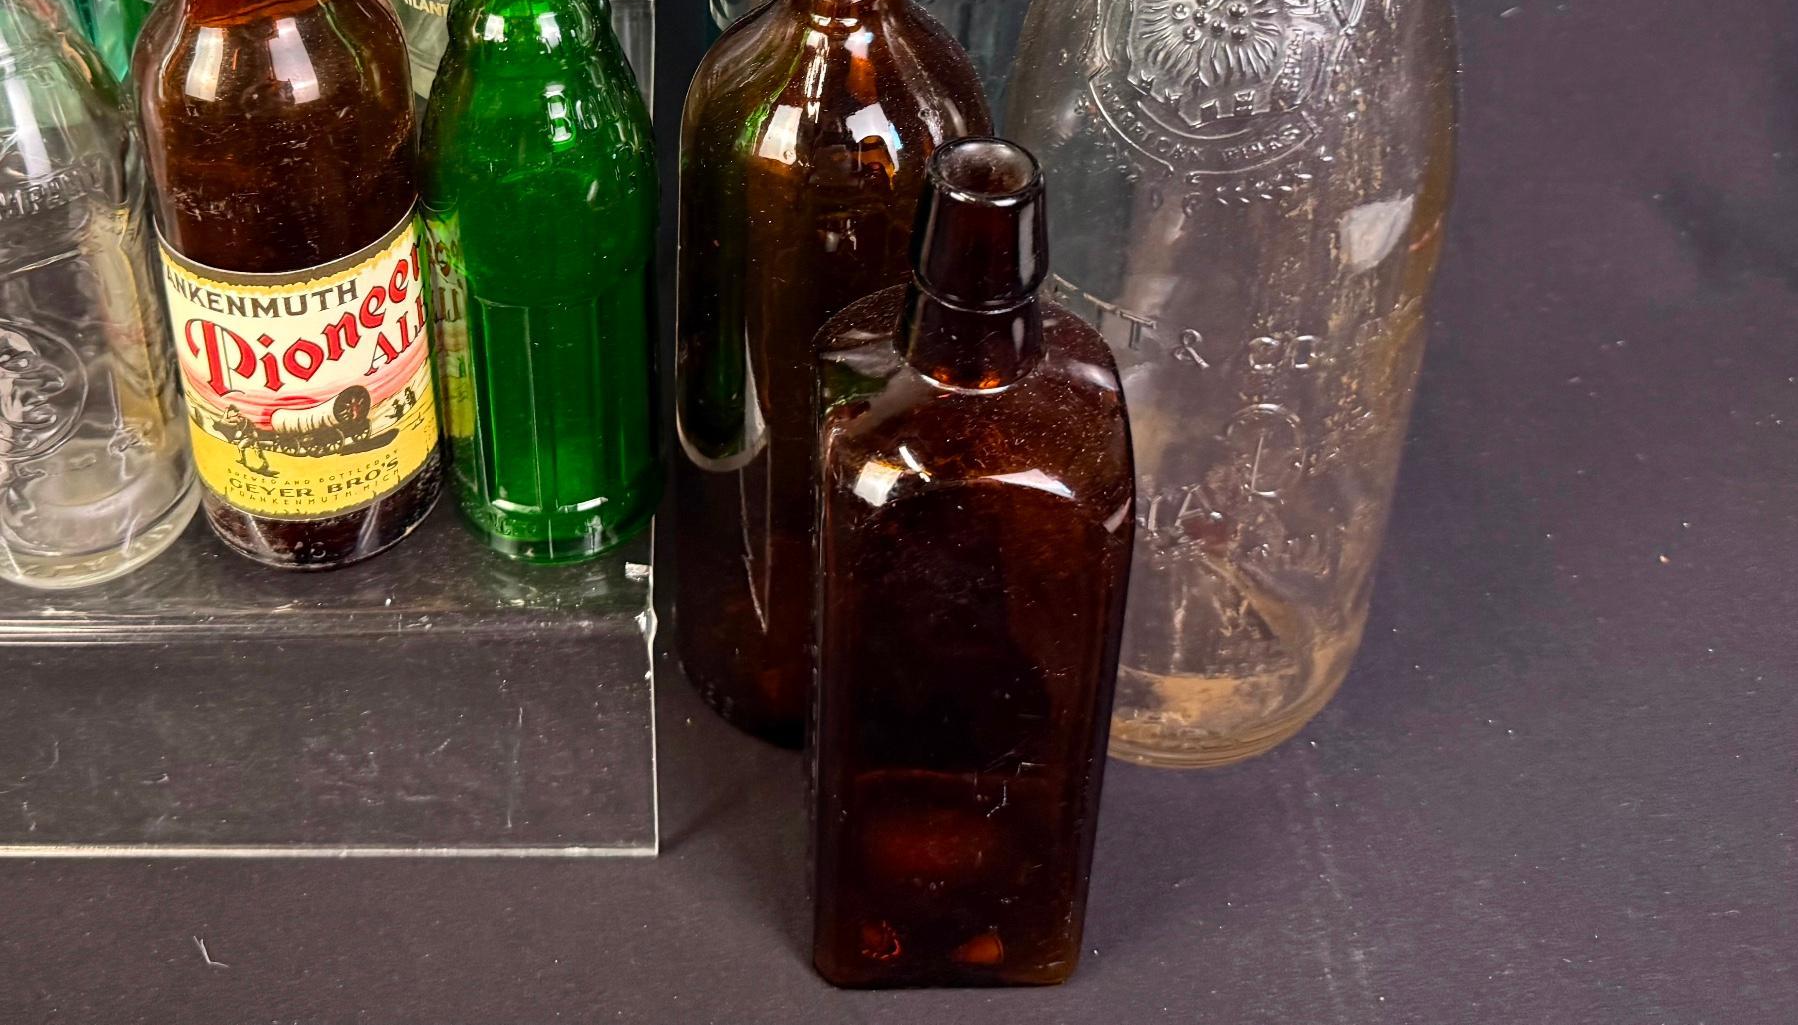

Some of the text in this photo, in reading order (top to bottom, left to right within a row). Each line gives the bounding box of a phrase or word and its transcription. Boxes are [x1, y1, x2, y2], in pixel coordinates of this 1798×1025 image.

[229, 457, 399, 498] GEYER BRO'S
[319, 459, 380, 483] BOTTLED
